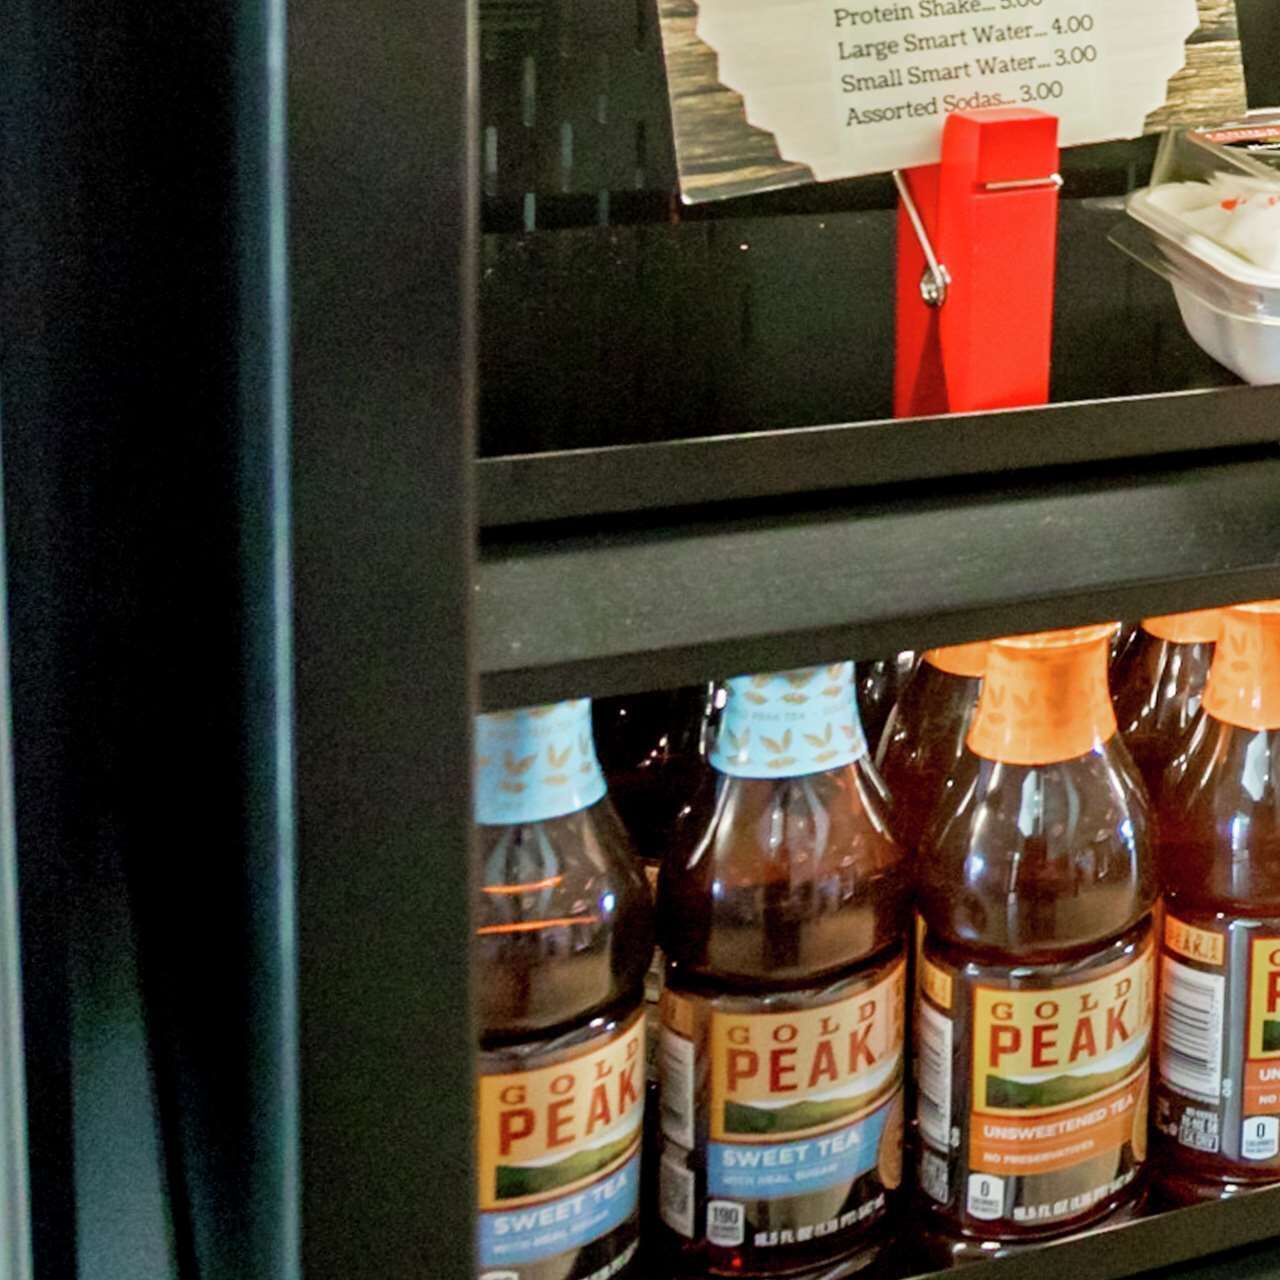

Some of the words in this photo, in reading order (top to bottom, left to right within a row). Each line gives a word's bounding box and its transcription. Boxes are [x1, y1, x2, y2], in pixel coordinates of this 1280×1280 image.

[834, 4, 913, 28] Protein
[838, 38, 899, 61] Large
[904, 29, 967, 53] Smart
[1051, 14, 1094, 35] 4.00
[841, 70, 902, 93] Small
[908, 62, 971, 85] Smart
[1055, 45, 1097, 67] 3.00
[847, 97, 938, 127] Assorted
[1020, 80, 1064, 103] 3.00
[728, 1000, 876, 1044] GOLD
[990, 978, 1131, 1020] GOLD
[727, 1023, 876, 1093] PEAK
[989, 1000, 1130, 1069] PEAK
[499, 1038, 638, 1105] GOLD
[498, 1061, 638, 1156] PEAK
[983, 1109, 1106, 1141] UNSWEETENED
[1111, 1094, 1134, 1116] TEA
[722, 1146, 812, 1167] SWEET
[819, 1132, 860, 1157] TEA
[494, 1193, 585, 1235] SWEET
[591, 1171, 628, 1201] TEA
